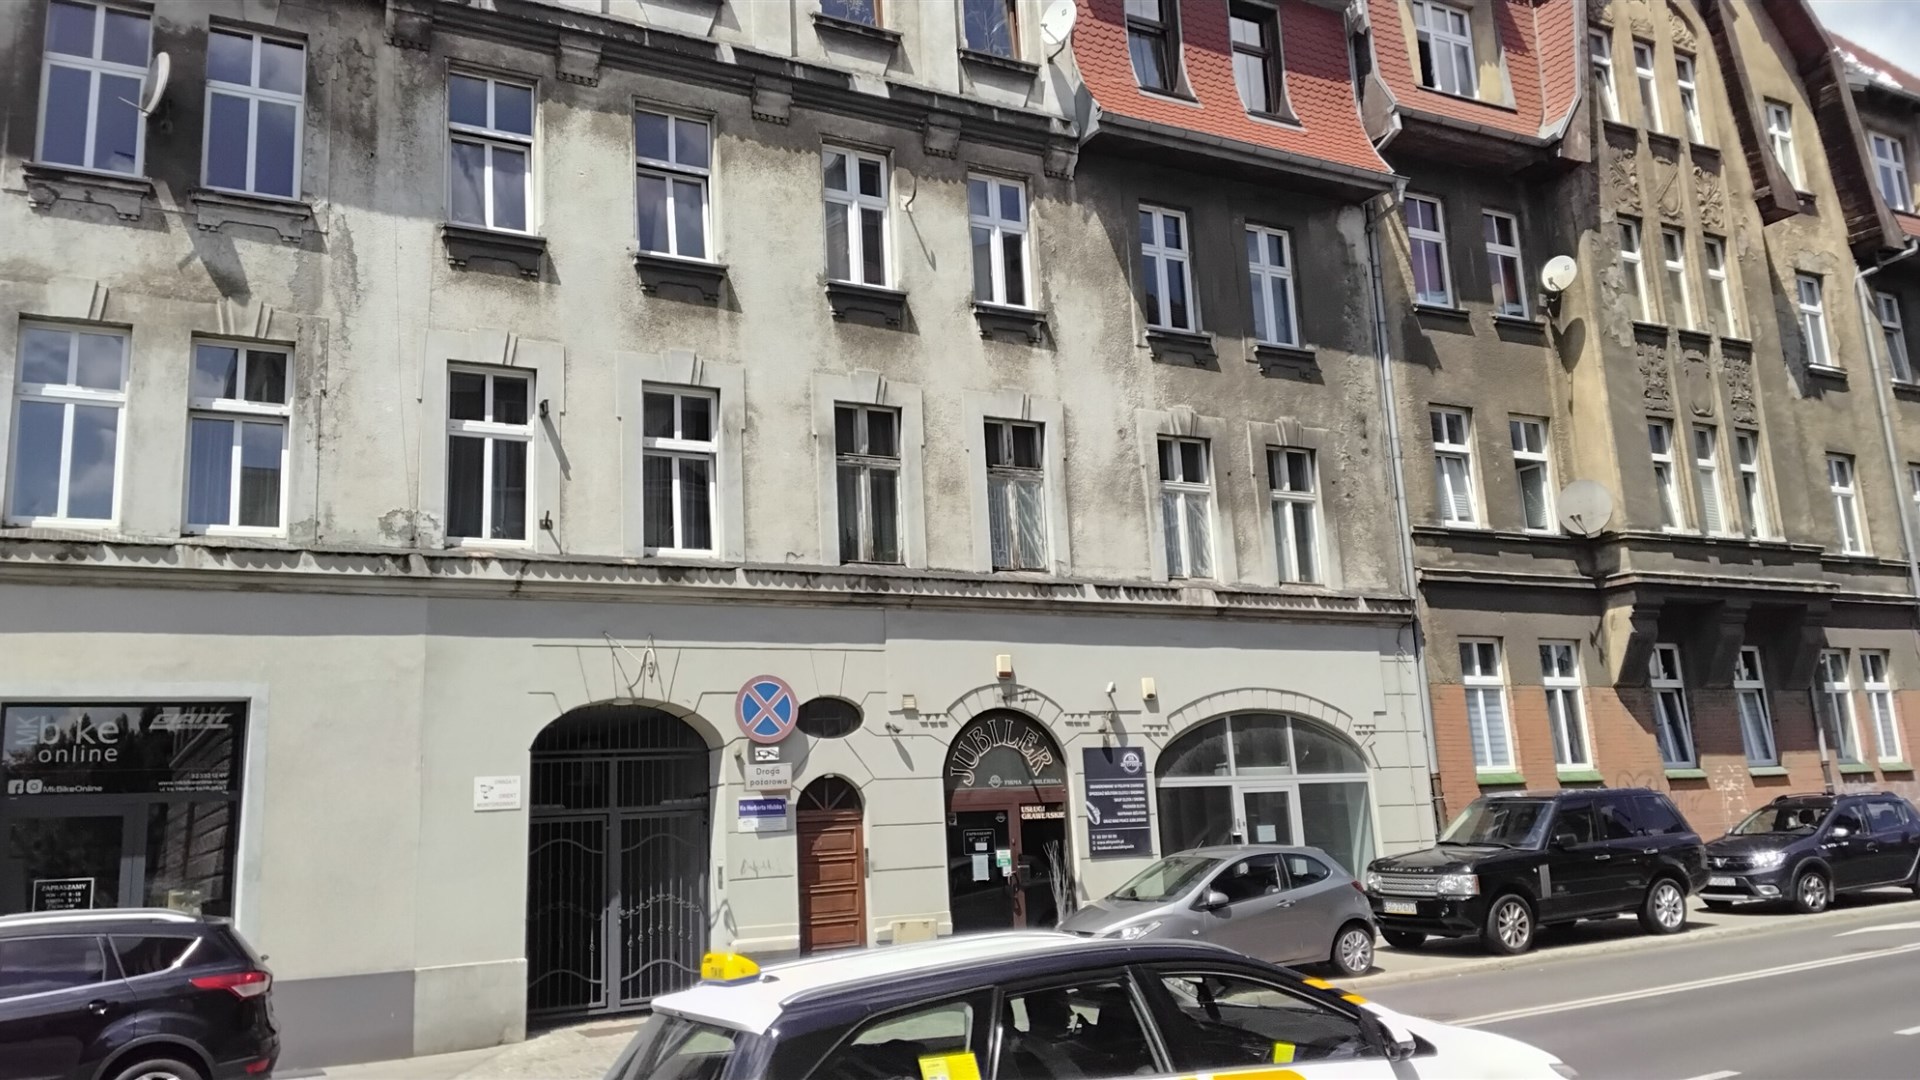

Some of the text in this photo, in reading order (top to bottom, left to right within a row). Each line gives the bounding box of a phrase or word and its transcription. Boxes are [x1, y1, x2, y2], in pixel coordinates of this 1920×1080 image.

[39, 715, 119, 745] bke
[38, 745, 118, 762] online
[951, 719, 1053, 787] JUBILER
[756, 767, 780, 776] Droga
[43, 785, 103, 793] MkBikeOnline
[750, 778, 788, 787] pożarowa
